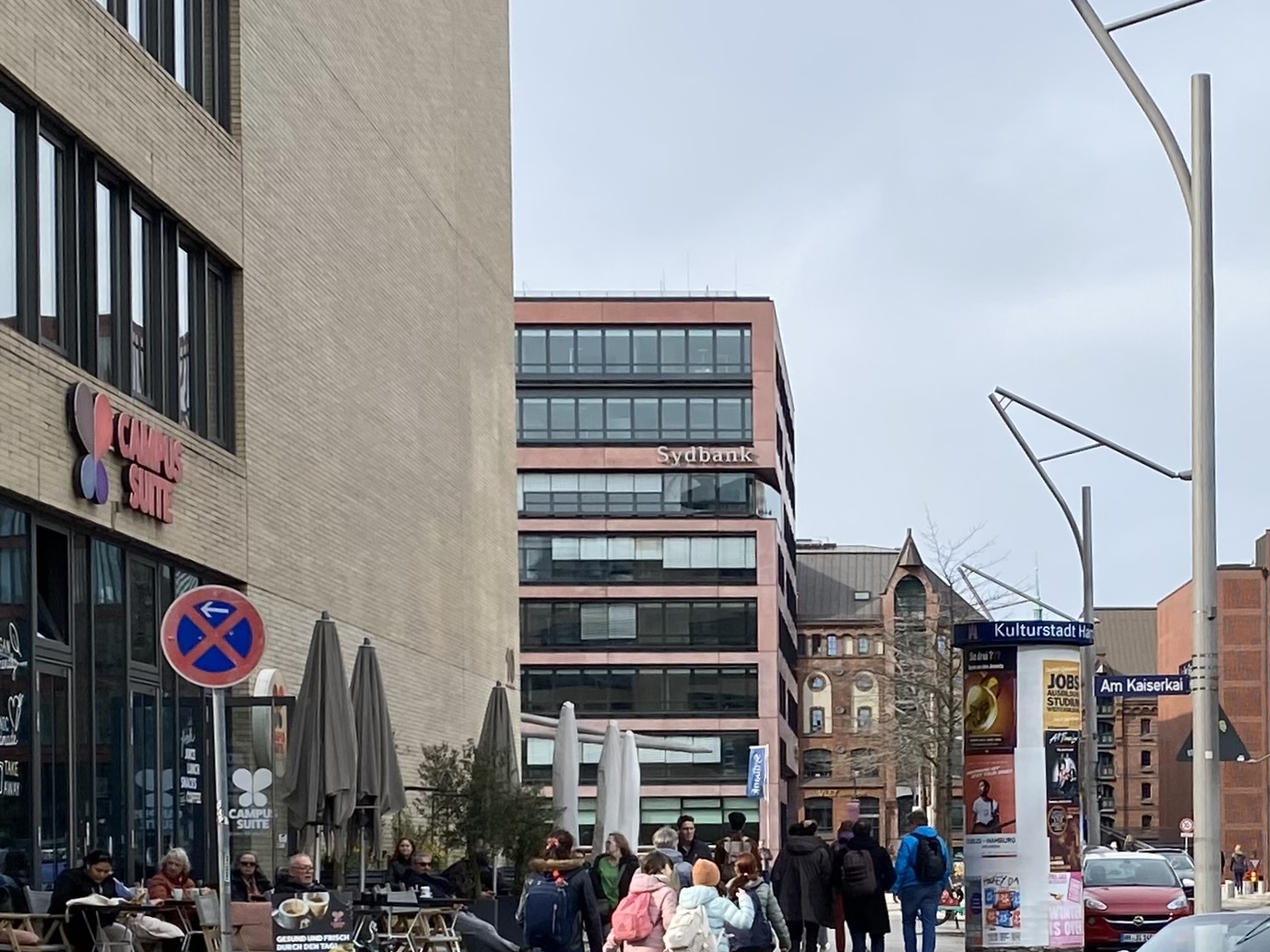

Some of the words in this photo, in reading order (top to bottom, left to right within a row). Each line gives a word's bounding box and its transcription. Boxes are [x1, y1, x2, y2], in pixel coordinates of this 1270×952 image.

[118, 412, 183, 483] CAMPUS
[657, 446, 753, 466] Sydbank
[129, 463, 174, 524] SUITE
[995, 623, 1076, 638] Kulturstadt
[1047, 673, 1080, 690] JOBS
[1100, 679, 1123, 692] Am
[1126, 677, 1184, 692] Kaiserkai
[237, 819, 270, 829] SUITE
[276, 935, 307, 943] GESUND
[323, 934, 350, 942] FRISCH
[276, 943, 303, 951] DURCH
[303, 943, 320, 951] DEN
